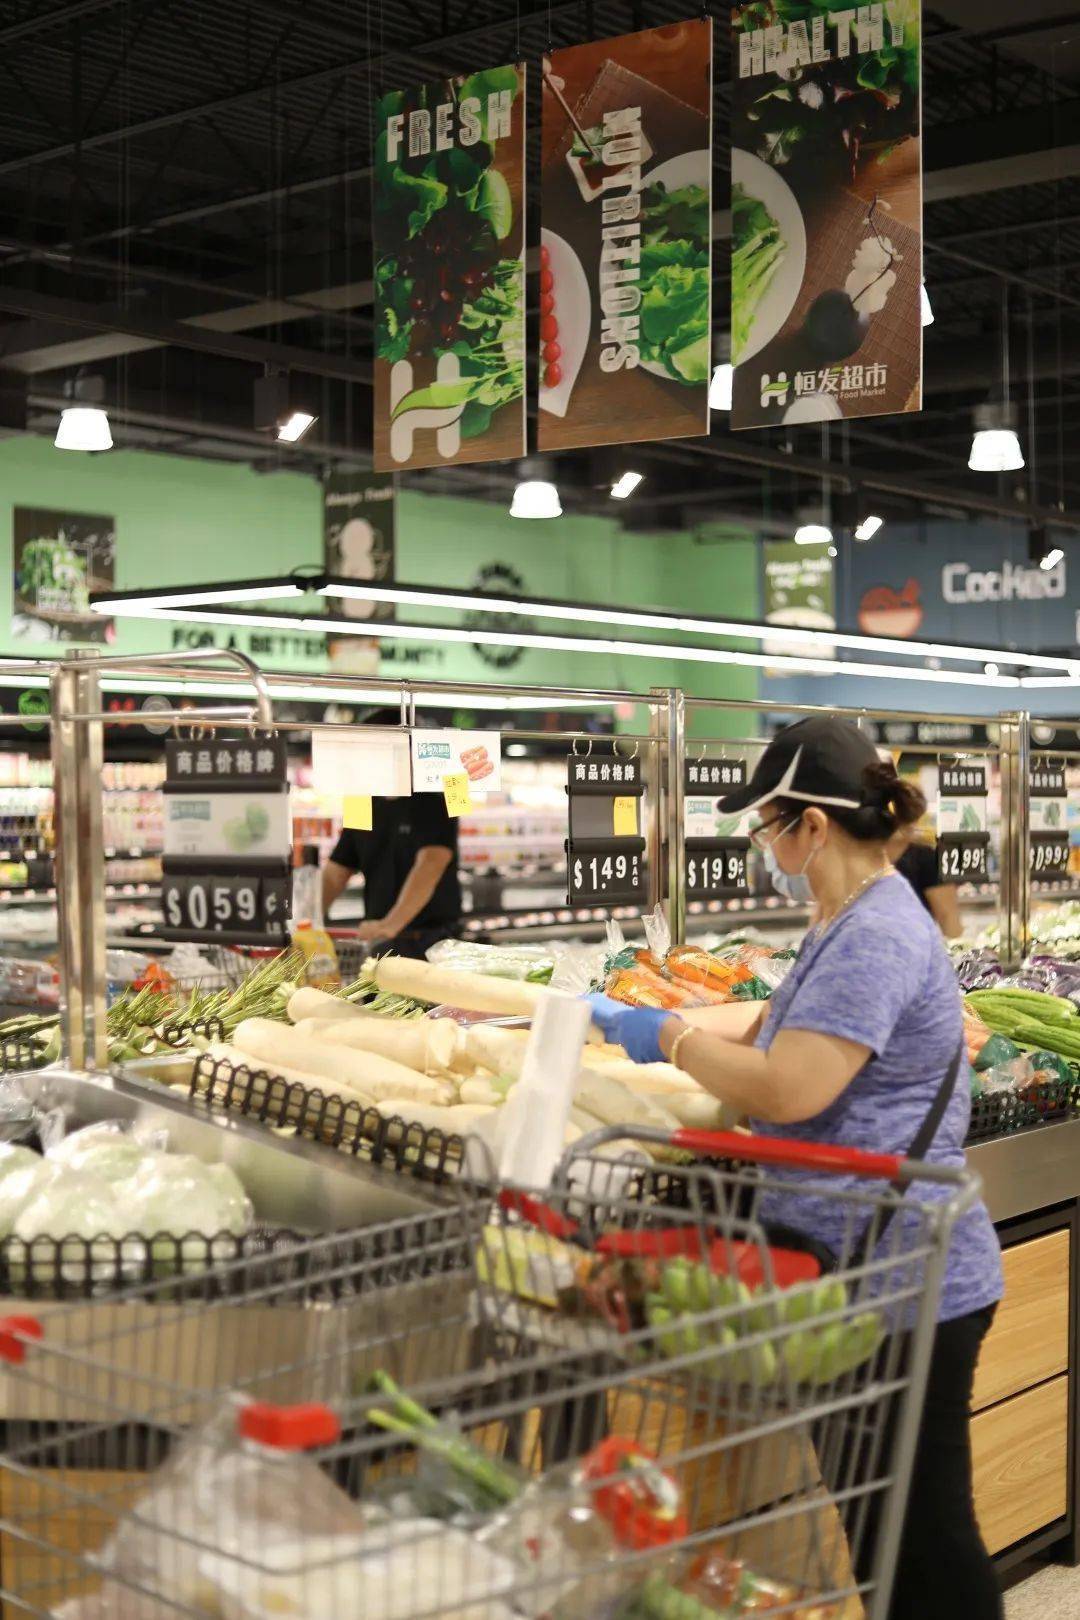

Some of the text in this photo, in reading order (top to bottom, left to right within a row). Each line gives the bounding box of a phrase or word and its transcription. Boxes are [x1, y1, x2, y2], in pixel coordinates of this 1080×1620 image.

[739, 1, 905, 79] HEALTHY
[386, 89, 512, 163] FRESH
[599, 106, 642, 373] NUTRITIONS
[794, 362, 888, 396] 恒发超市
[840, 391, 859, 399] Food
[861, 388, 887, 398] Market
[942, 559, 1067, 604] Cooked
[172, 628, 215, 650] FOR
[176, 749, 275, 775] 商品价格牌
[575, 763, 635, 782] 商品价格牌
[688, 766, 743, 784] 商品价格牌
[573, 855, 628, 890] $1.49
[687, 856, 739, 889] $1.99
[941, 847, 981, 876] $2.99
[166, 884, 257, 932] $0.59
